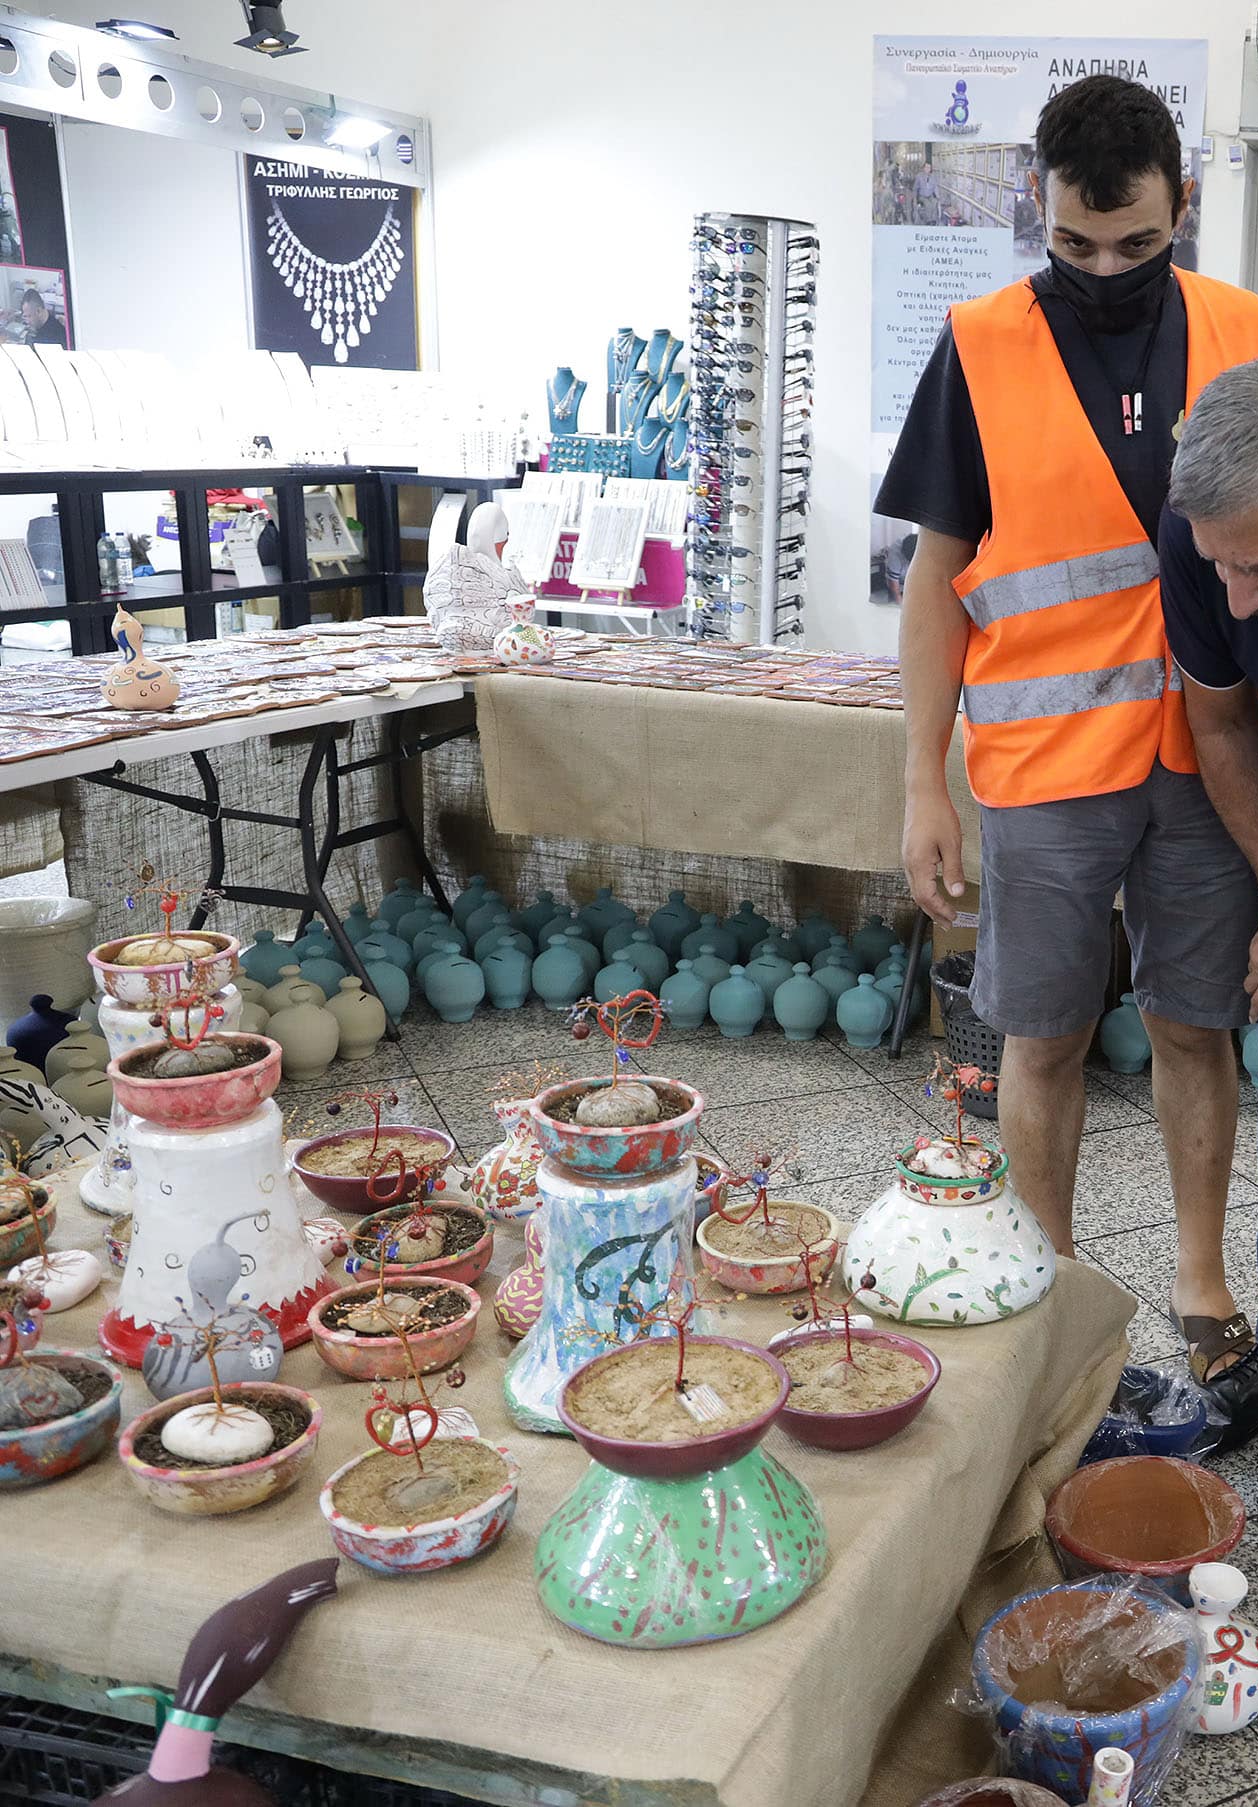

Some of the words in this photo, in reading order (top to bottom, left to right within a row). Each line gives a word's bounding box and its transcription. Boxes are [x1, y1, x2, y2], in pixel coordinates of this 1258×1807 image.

[886, 46, 956, 60] Συνεργασία
[968, 47, 1039, 61] Δημιουργία
[1048, 58, 1148, 78] ΑΝΑΠΗΡΙΑ
[254, 161, 309, 179] ΑΣΗΜΙ
[266, 184, 337, 199] ΤΡΙΦΥΛΛΗΣ
[340, 186, 400, 200] ΓΕΩΡΓΙΟΣ
[931, 258, 963, 266] (ΑΜΕΑ)
